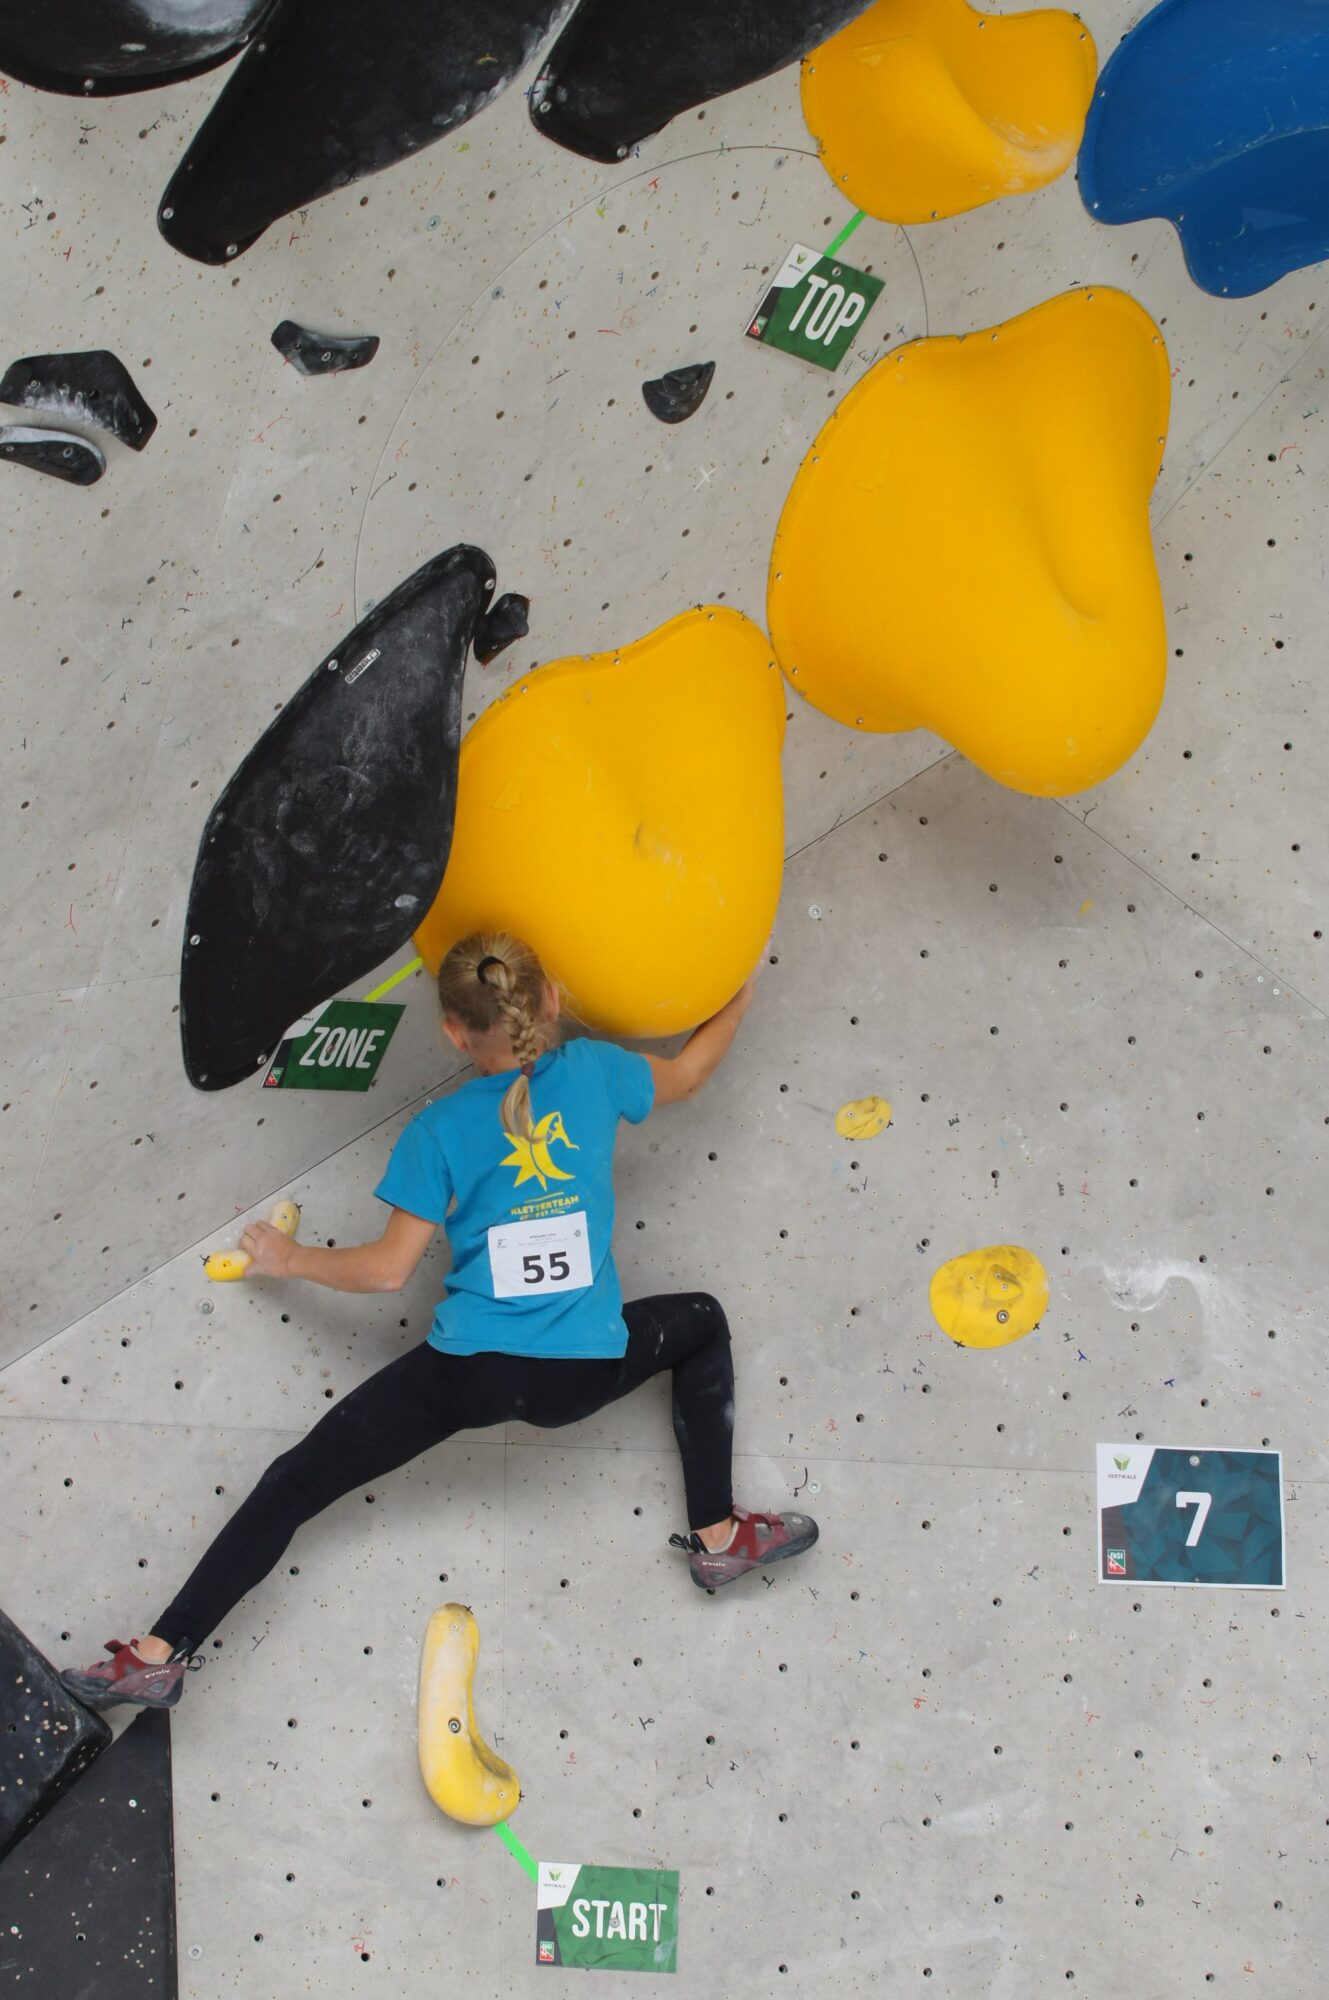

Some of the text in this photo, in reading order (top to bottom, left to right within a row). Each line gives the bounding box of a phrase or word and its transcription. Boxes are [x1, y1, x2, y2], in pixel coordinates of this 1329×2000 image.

[788, 274, 866, 346] TOP
[299, 1026, 386, 1069] ZONE
[511, 1195, 580, 1216] KLETTERTEAM
[522, 1251, 570, 1284] 55
[1176, 1491, 1212, 1547] 7
[571, 1898, 668, 1942] START
